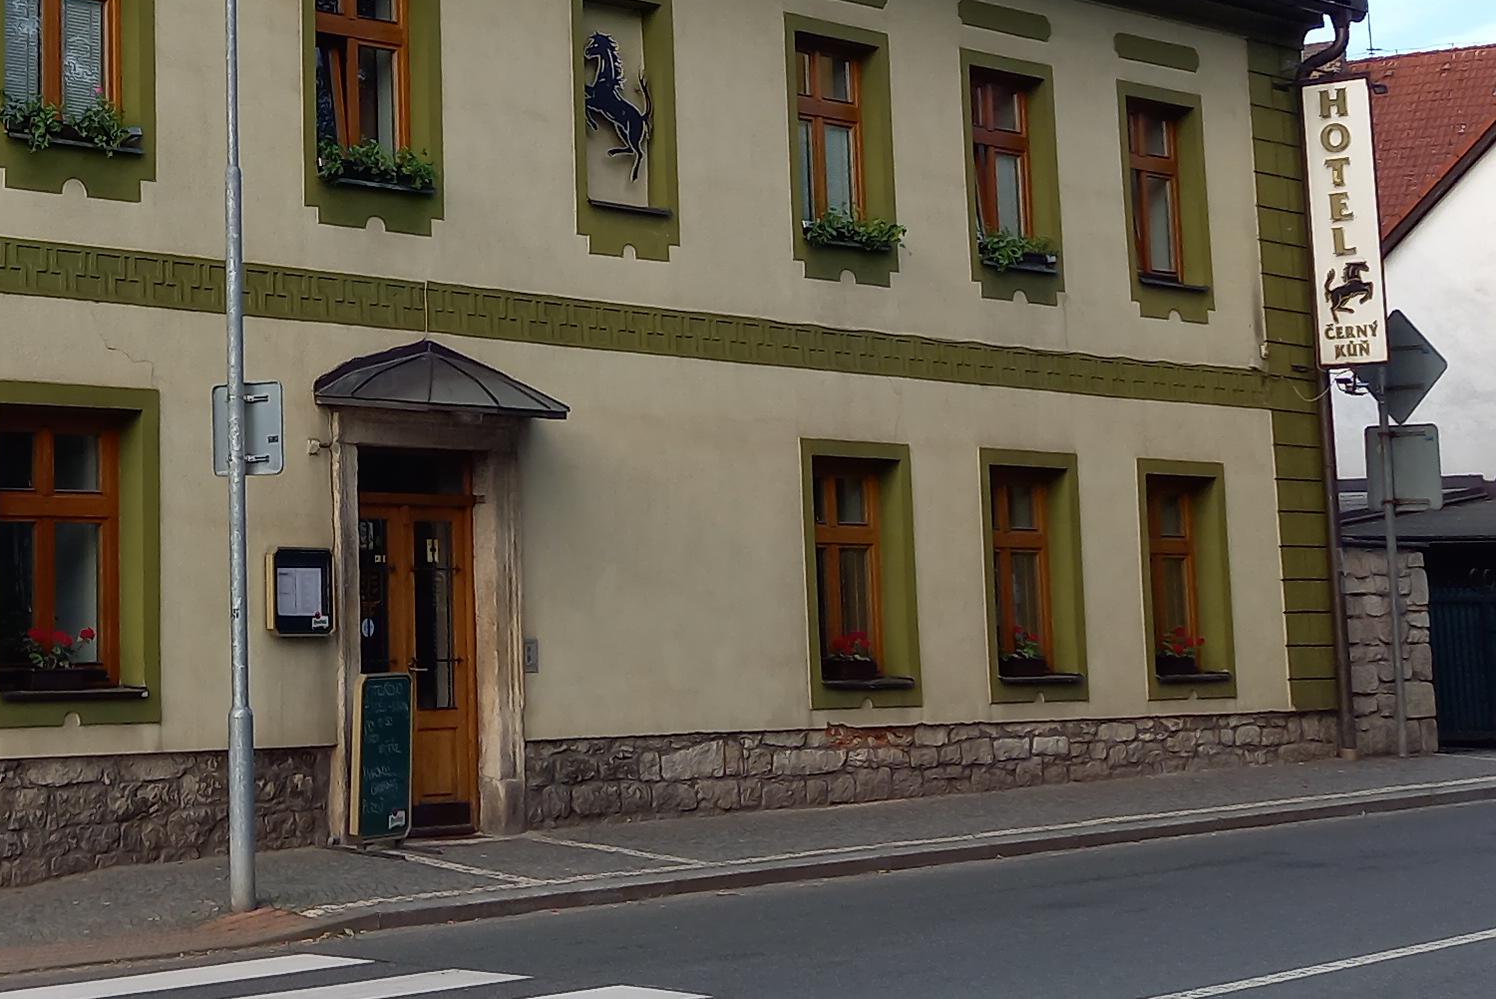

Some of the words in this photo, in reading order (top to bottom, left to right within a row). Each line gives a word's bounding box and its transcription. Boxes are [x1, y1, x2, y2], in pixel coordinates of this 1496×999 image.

[1318, 86, 1357, 257] HOTEL
[1324, 320, 1378, 340] ČERNÝ
[1334, 340, 1370, 359] KŮŇ
